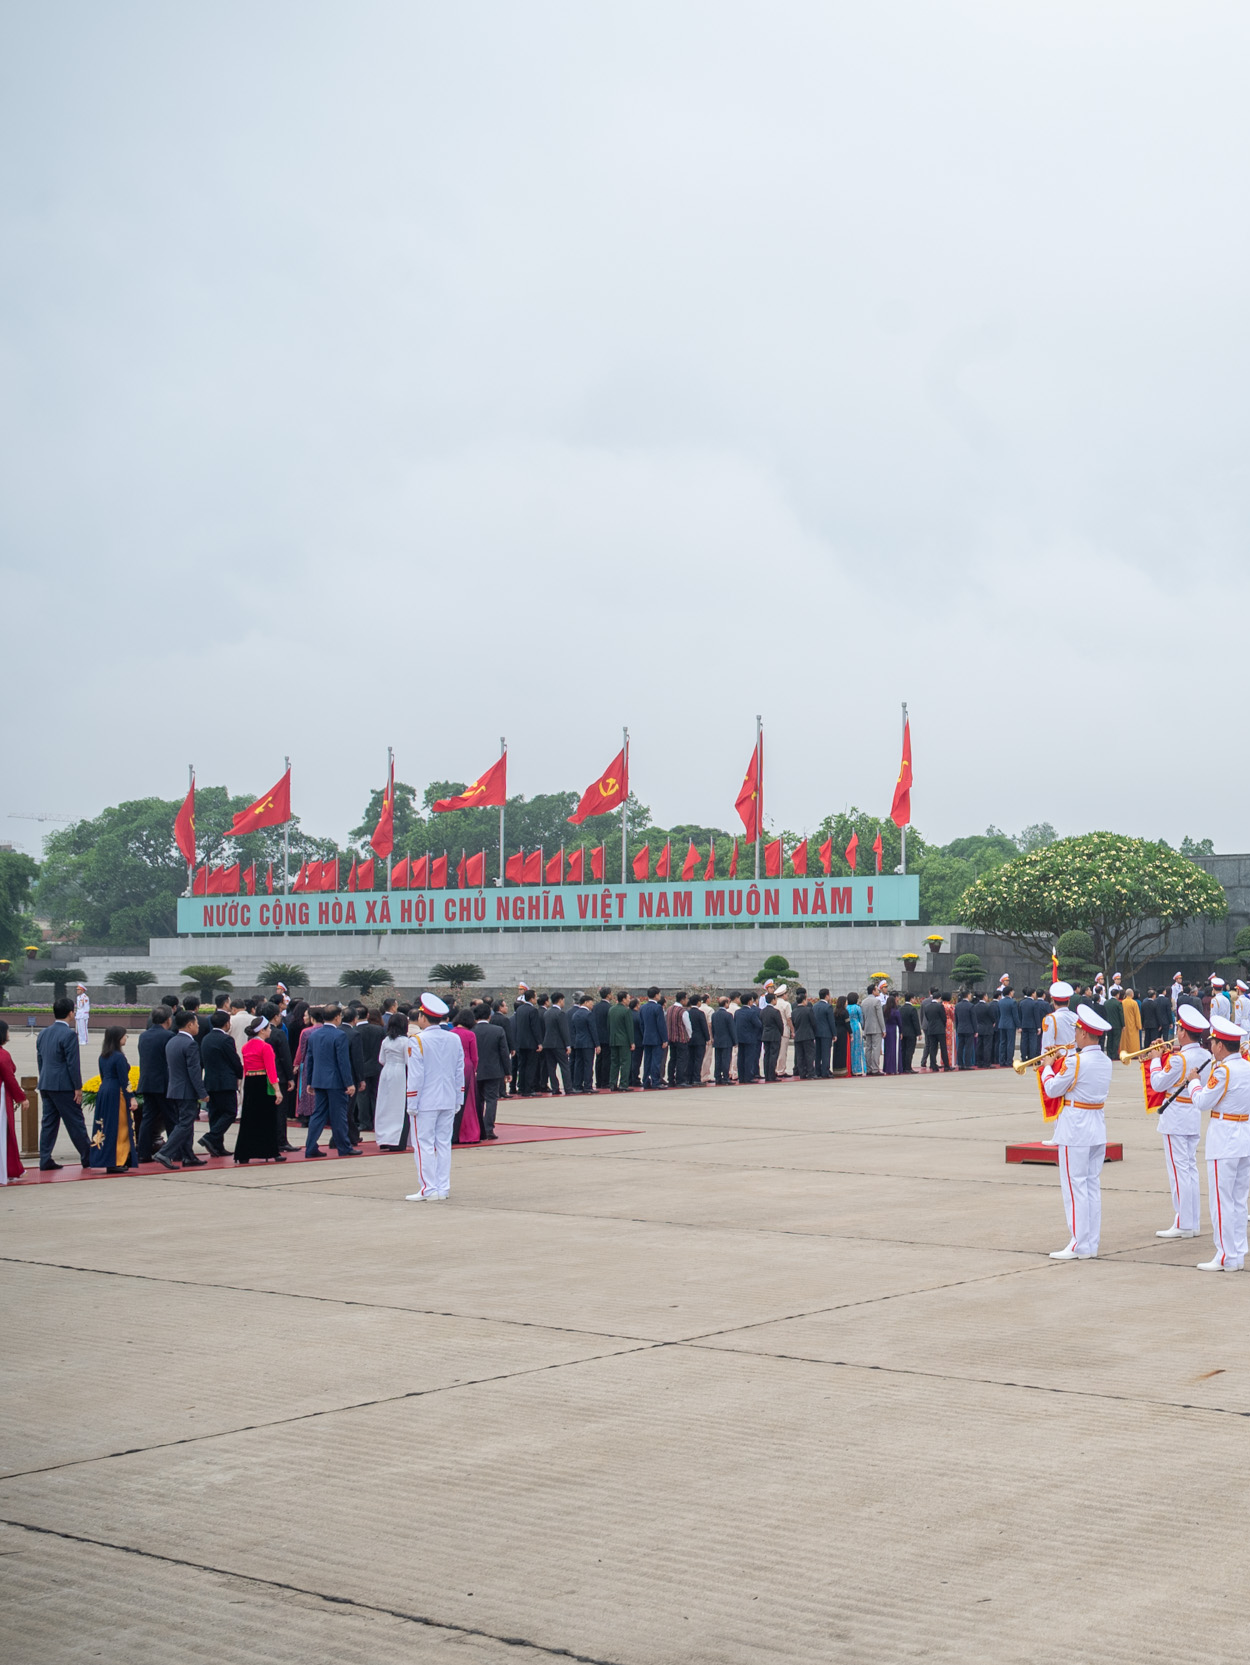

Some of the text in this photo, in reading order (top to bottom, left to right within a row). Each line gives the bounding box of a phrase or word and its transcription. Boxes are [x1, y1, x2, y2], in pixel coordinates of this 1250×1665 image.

[203, 899, 251, 927] NƯỚC
[259, 898, 310, 930] CỘNG
[318, 896, 357, 925] HÒA
[366, 895, 392, 924] XÃ
[400, 894, 435, 927] HỘI
[444, 889, 487, 922] CHỦ
[496, 889, 565, 921] NGHĨA
[577, 888, 628, 924] VIỆT
[638, 890, 693, 918] NAM
[704, 883, 780, 917] MUÔN
[792, 881, 853, 915] NĂM
